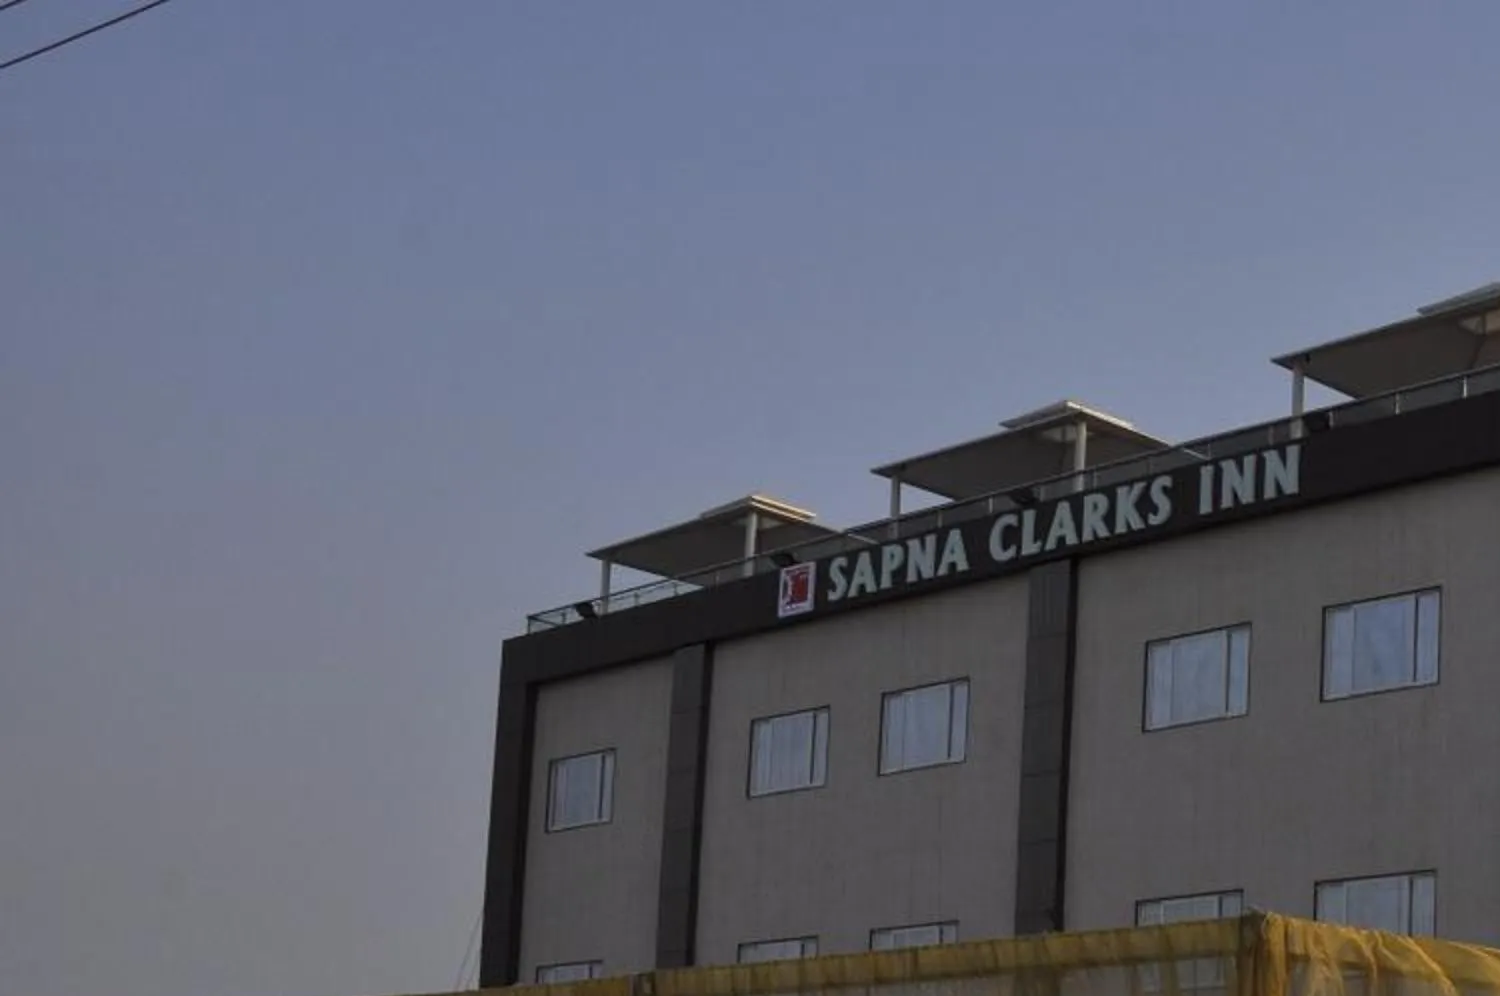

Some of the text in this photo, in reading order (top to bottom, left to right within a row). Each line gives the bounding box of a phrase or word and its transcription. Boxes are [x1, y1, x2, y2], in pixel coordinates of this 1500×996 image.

[827, 445, 1299, 600] SAPNA CLARKS INN
